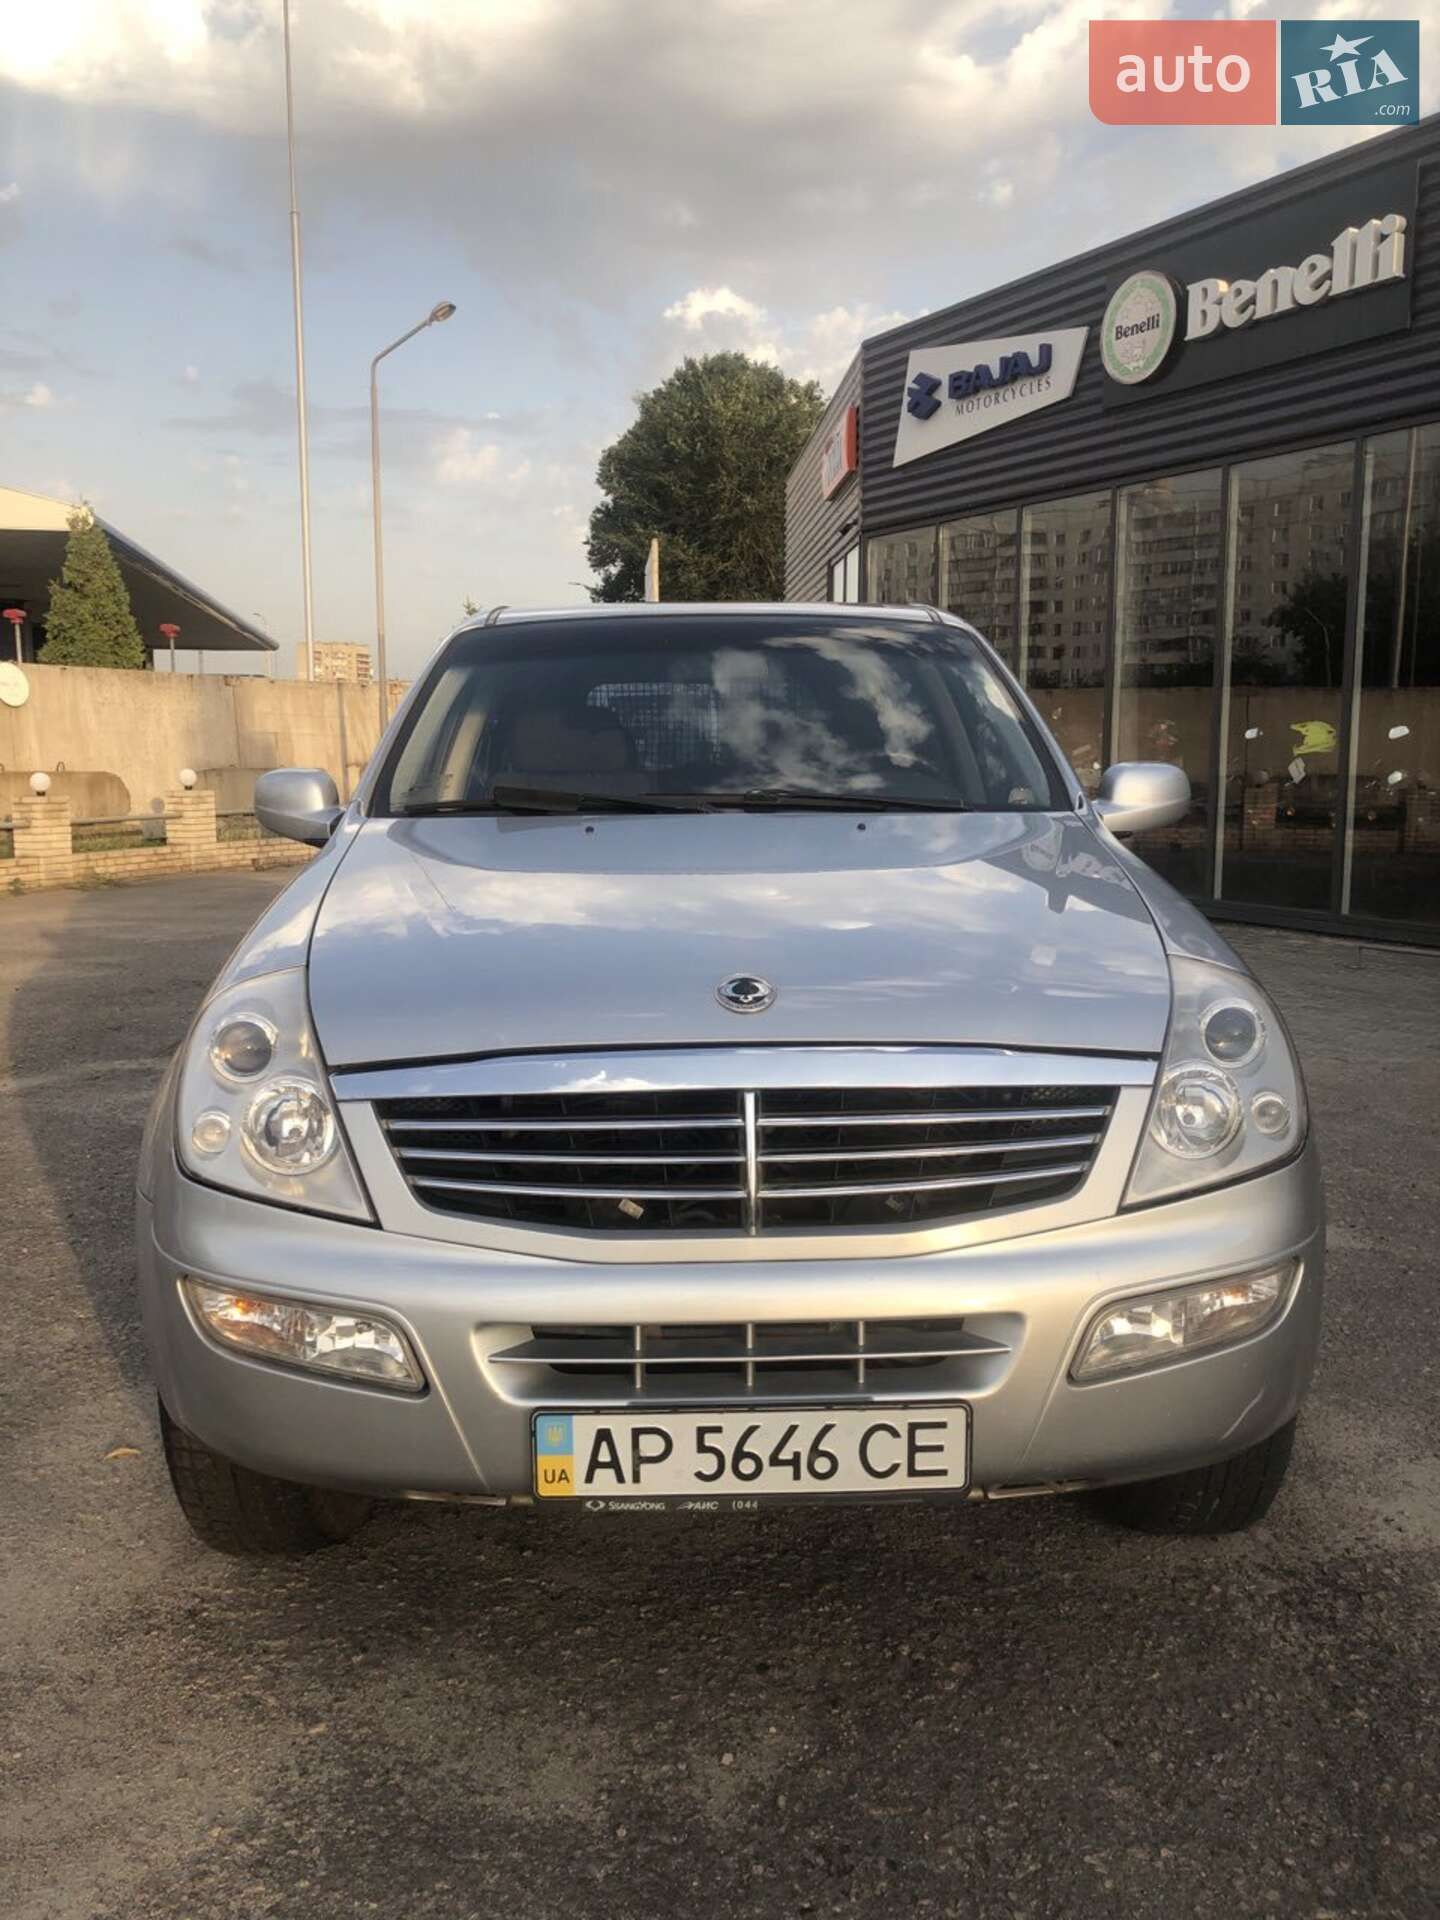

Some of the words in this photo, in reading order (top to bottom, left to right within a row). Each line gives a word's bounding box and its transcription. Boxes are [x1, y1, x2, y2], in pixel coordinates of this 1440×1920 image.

[1183, 214, 1408, 341] Benelli
[1115, 313, 1160, 341] Benelli
[948, 343, 1053, 400] BAJAJ
[955, 376, 1051, 415] MOTORCYCLES
[543, 1468, 570, 1484] UA
[584, 1426, 673, 1484] AP
[694, 1423, 838, 1482] 5646
[858, 1420, 949, 1478] CE
